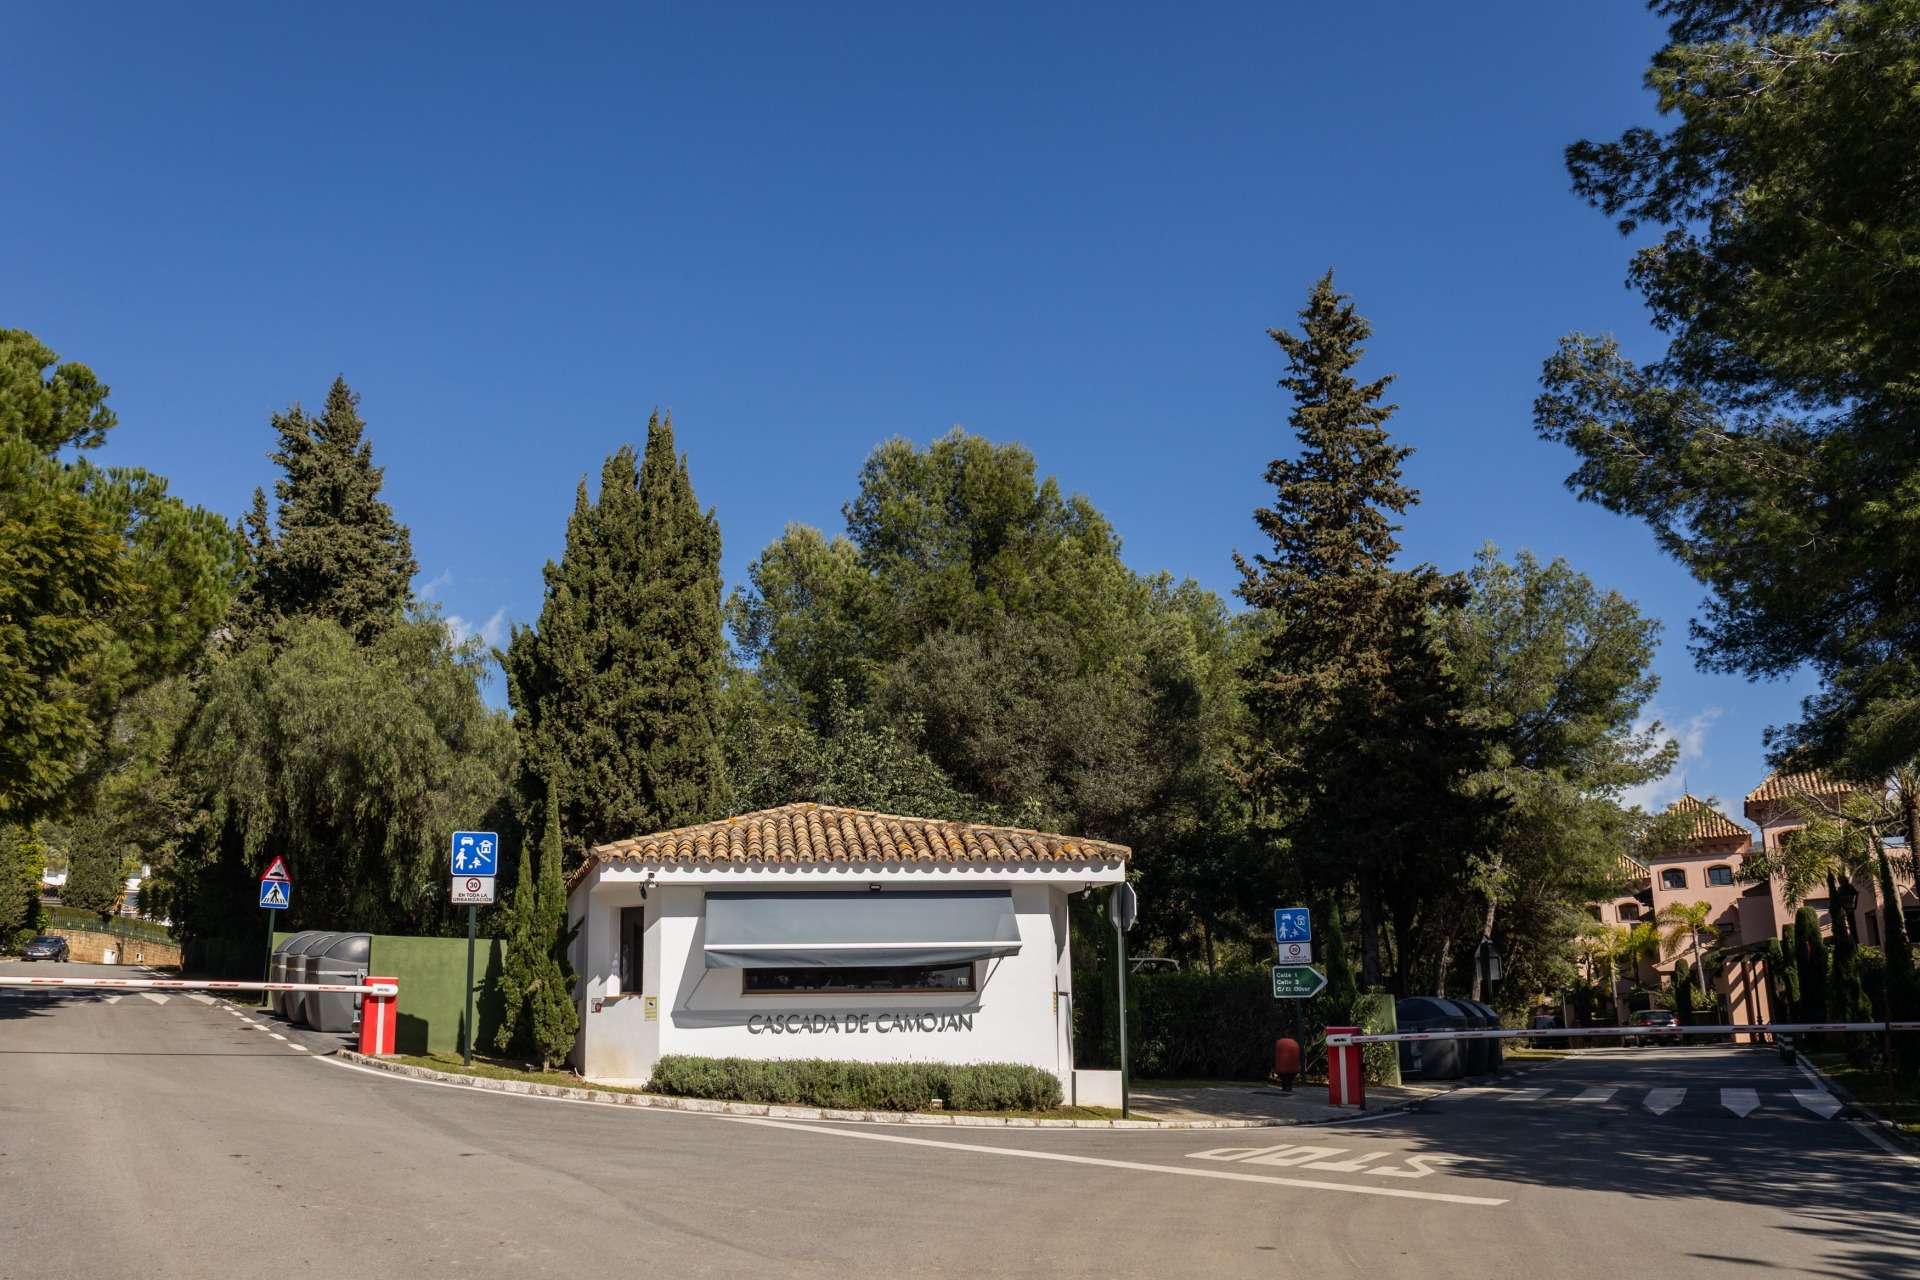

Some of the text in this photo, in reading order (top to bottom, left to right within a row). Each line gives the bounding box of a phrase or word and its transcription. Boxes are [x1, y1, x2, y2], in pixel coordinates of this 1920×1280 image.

[747, 1013, 973, 1035] CASCADA DE CAMOJAN
[1185, 1144, 1465, 1178] STOP
